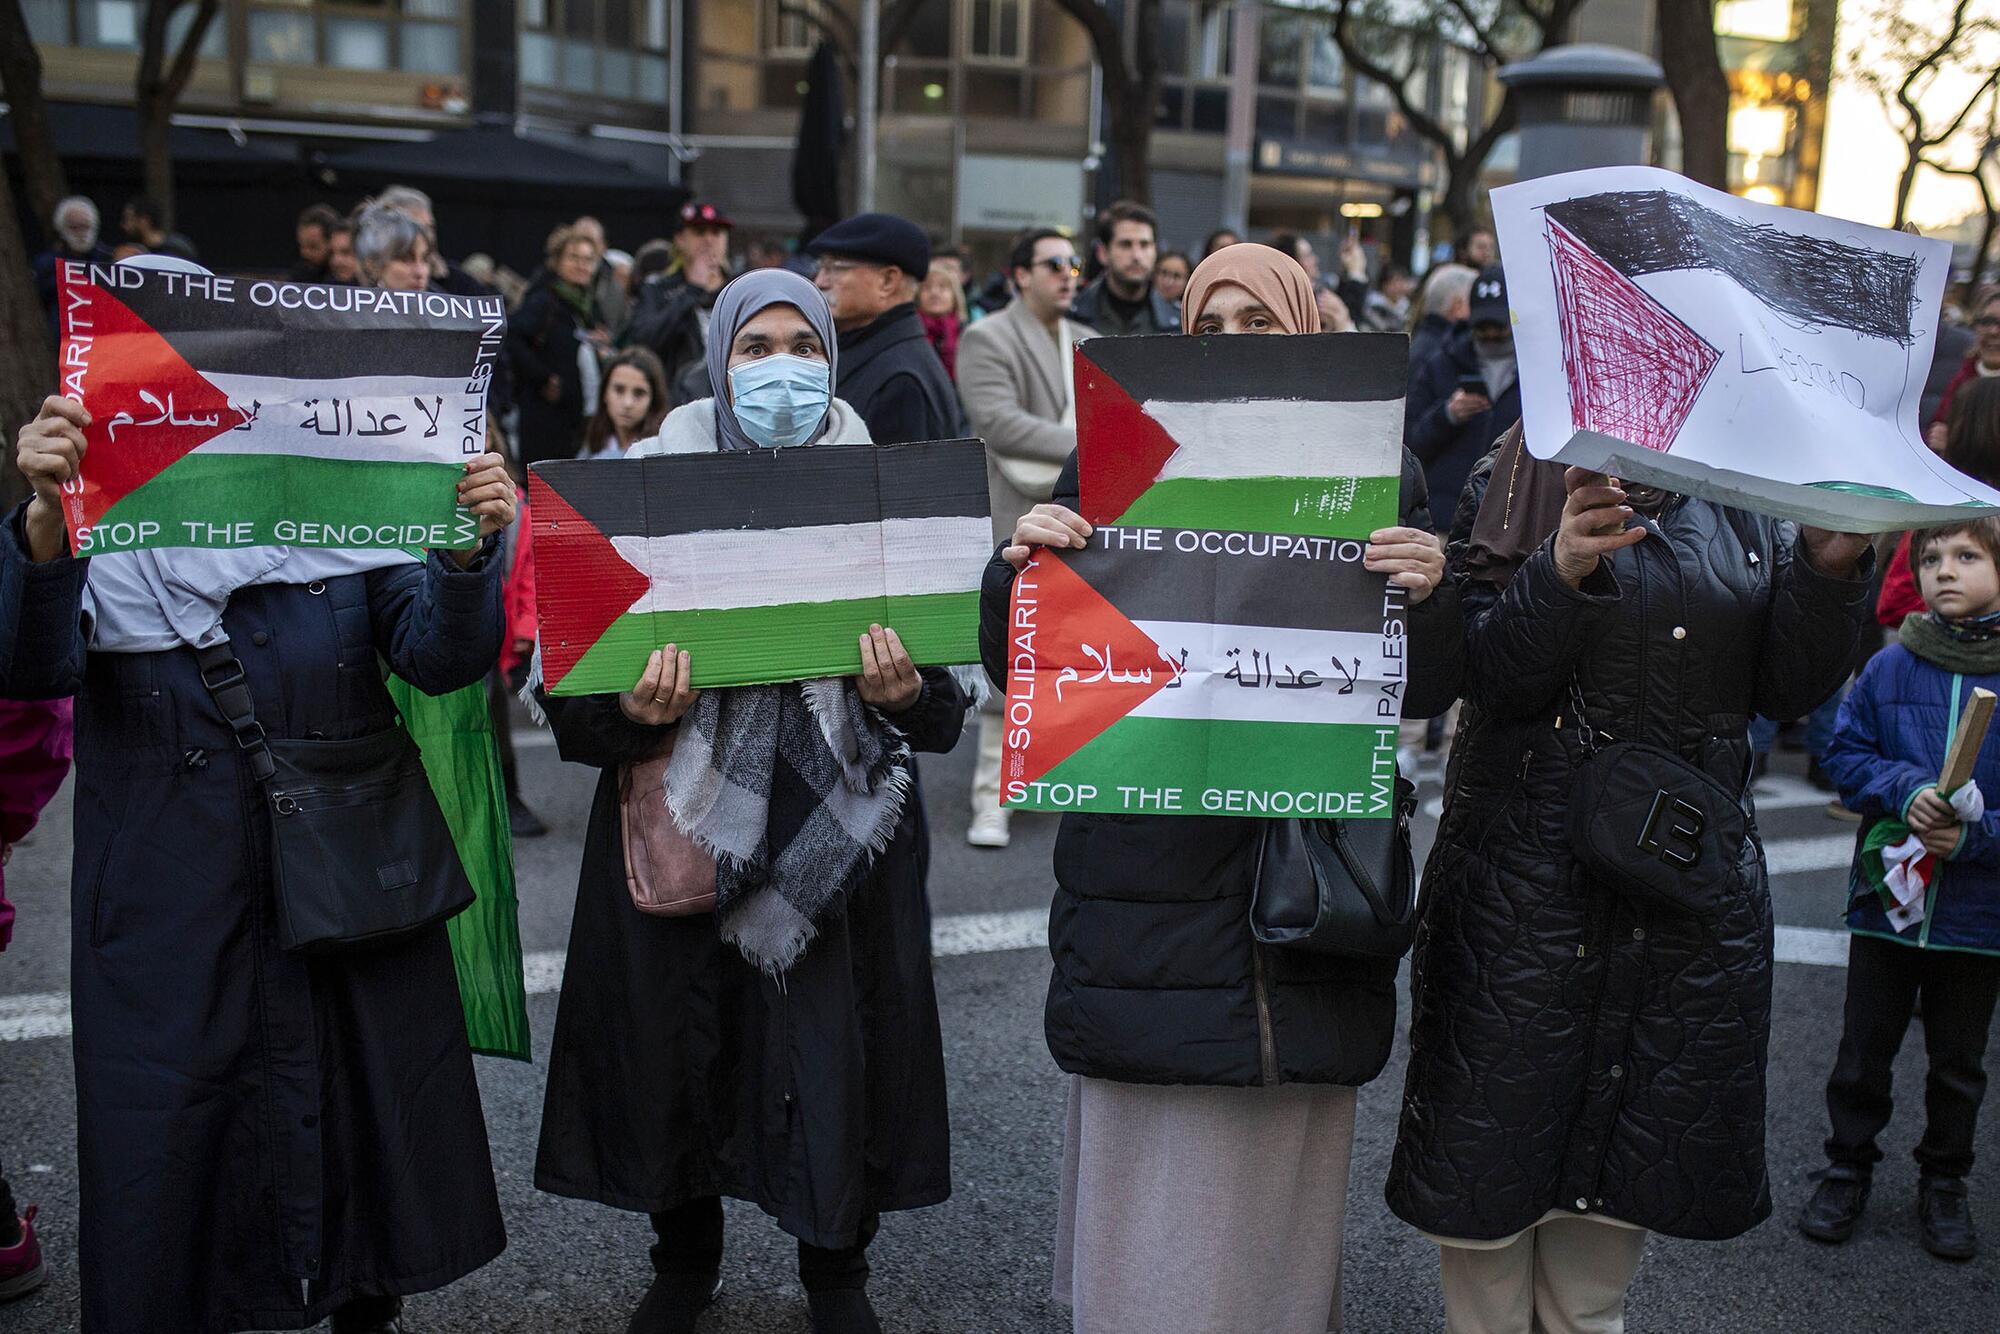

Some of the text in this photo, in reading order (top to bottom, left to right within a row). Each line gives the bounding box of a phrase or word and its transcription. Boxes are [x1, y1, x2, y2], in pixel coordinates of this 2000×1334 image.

[65, 261, 473, 319] END THE OCCUPATION
[62, 288, 94, 495] SARITY
[463, 298, 503, 455] PALESTINE
[107, 388, 443, 442] لا عدالة لا سلام
[76, 520, 448, 552] STOP THE GENOCIDE
[1096, 525, 1371, 564] THE OCCUPATIO
[1008, 559, 1040, 751] SOLIDARITY
[1055, 643, 1362, 702] لا عدالة لا سلام
[1368, 578, 1406, 813] WITH PALESTI
[1006, 780, 1364, 814] STOP THE GENOCIDE
